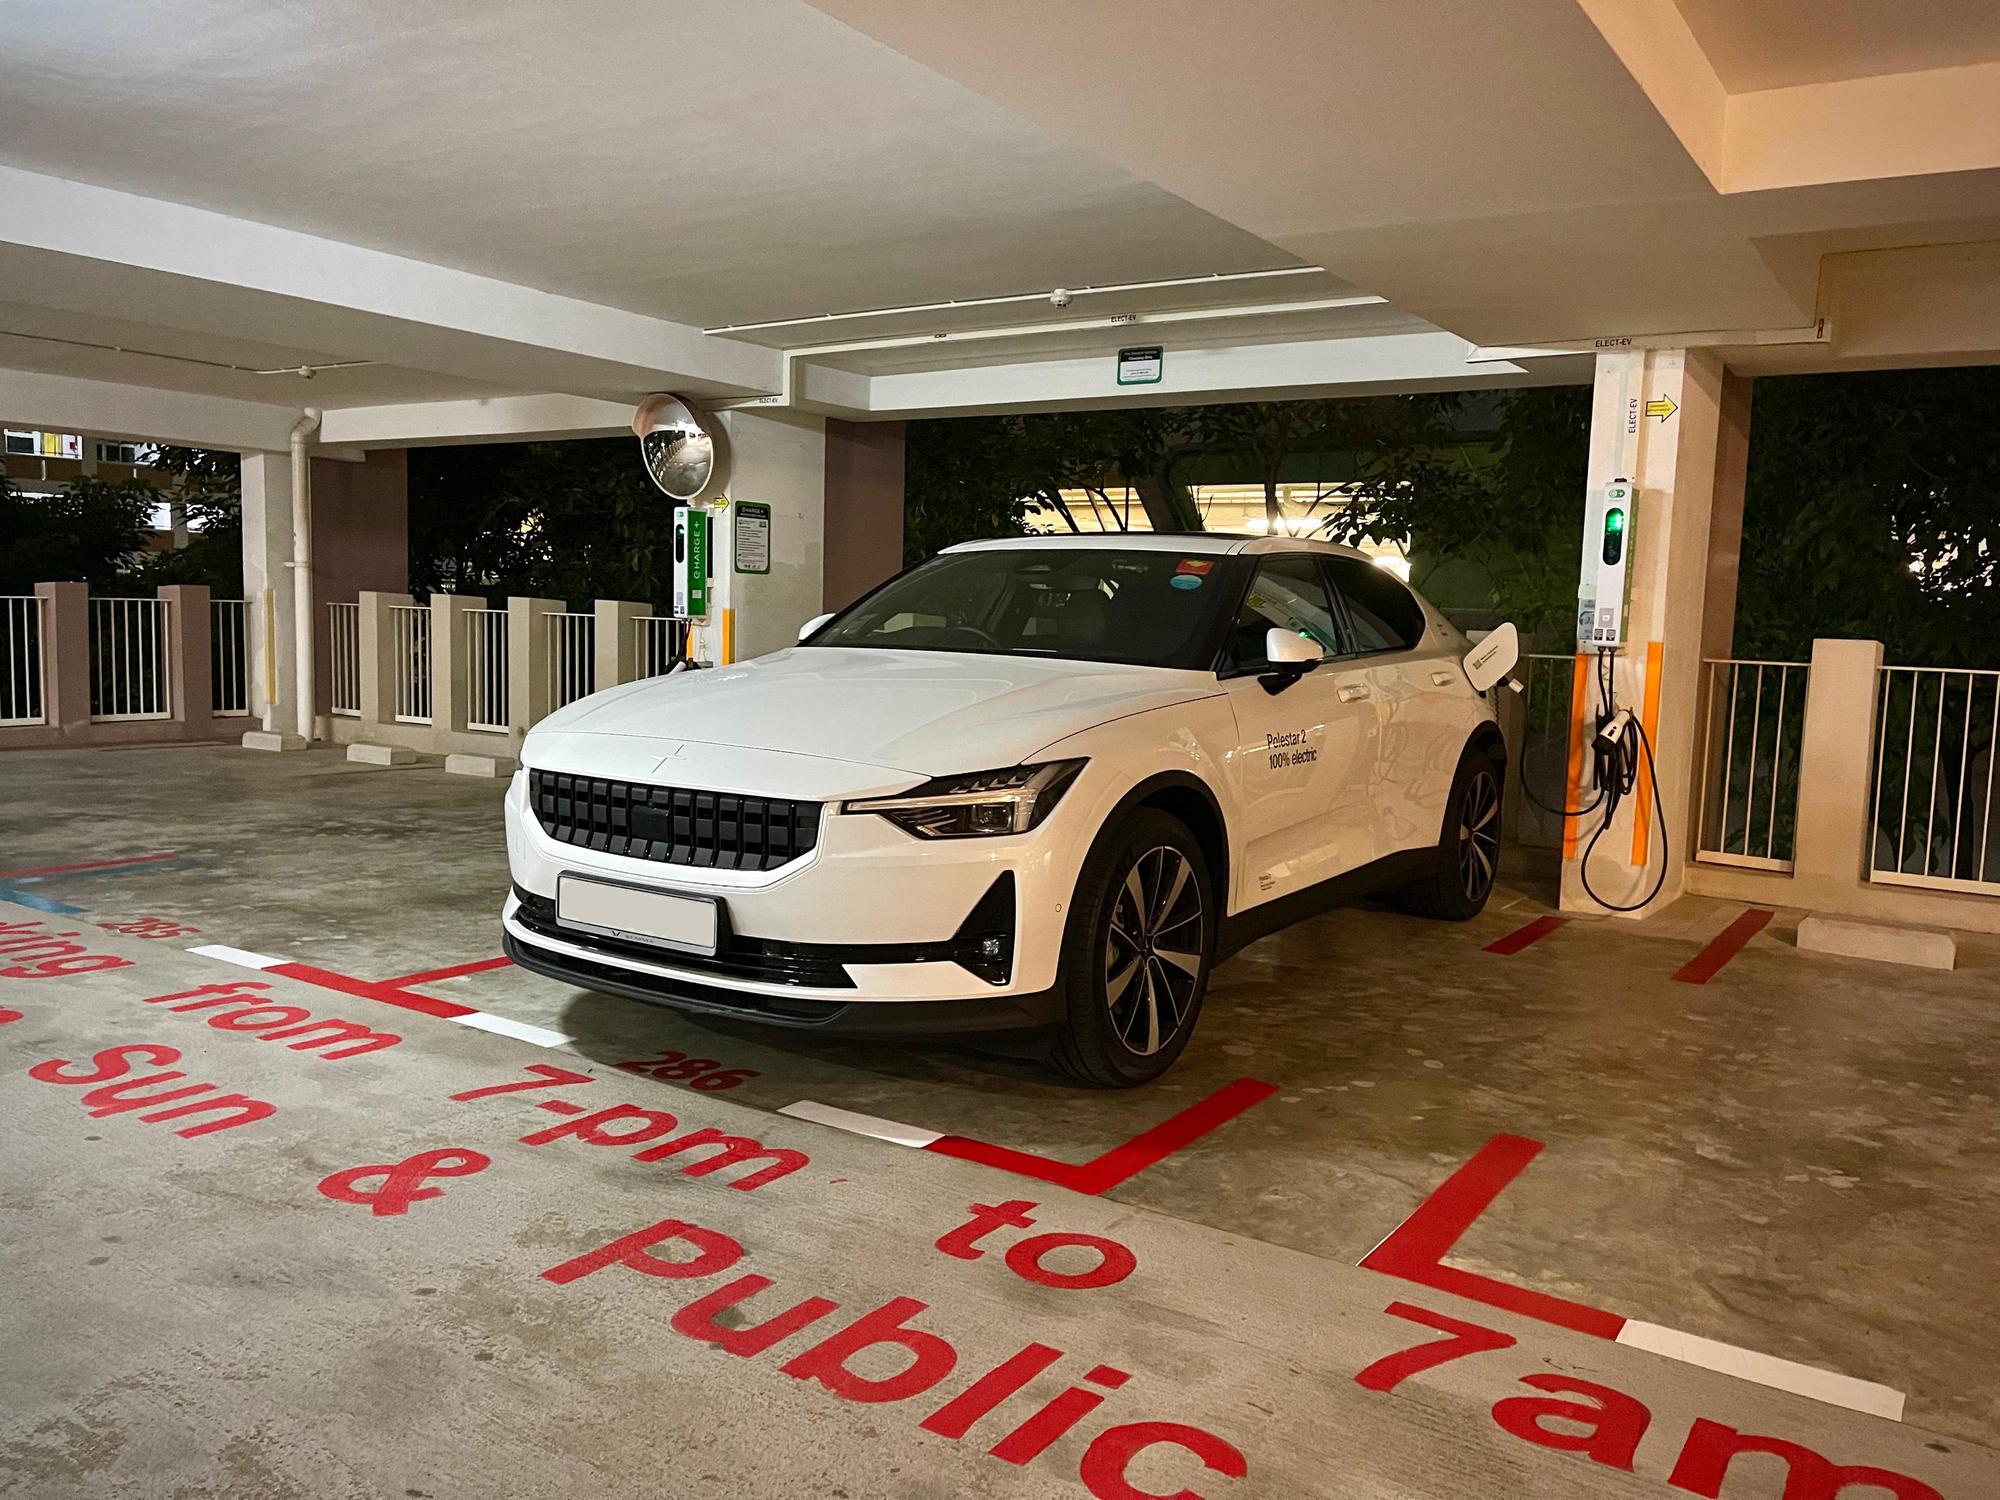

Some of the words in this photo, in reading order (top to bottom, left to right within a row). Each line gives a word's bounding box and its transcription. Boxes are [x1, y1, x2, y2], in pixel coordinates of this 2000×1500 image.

[1595, 338, 1632, 347] ELECT-EV
[1628, 398, 1638, 434] ELECT-EV
[693, 530, 701, 580] CHARGE
[1266, 731, 1300, 749] Polestar
[1300, 729, 1307, 744] 2
[1269, 751, 1290, 770] 100%
[1291, 746, 1317, 766] electric
[613, 1050, 762, 1091] 286
[143, 981, 402, 1062] from
[933, 1199, 1138, 1291] to
[28, 1043, 277, 1139] Sun
[316, 1147, 491, 1218] &
[539, 1218, 1248, 1500] Public
